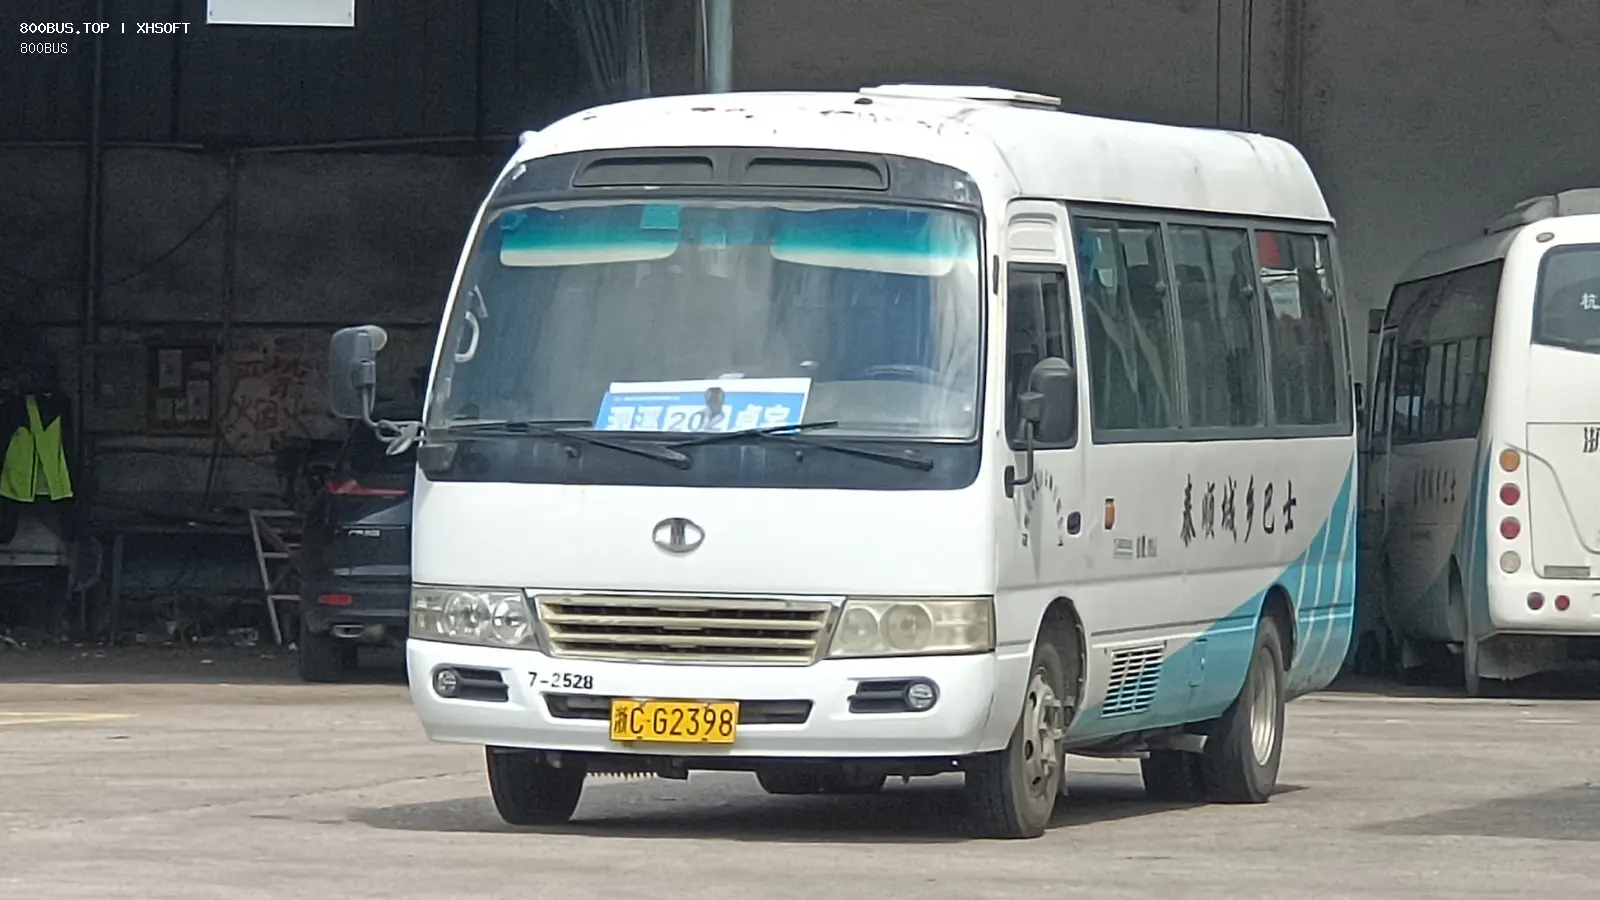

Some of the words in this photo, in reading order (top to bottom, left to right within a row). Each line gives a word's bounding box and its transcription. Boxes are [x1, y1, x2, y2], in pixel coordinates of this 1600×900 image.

[669, 410, 727, 432] 202
[1180, 473, 1297, 547] 泰顺城乡巴士
[528, 671, 593, 689] 7-2528
